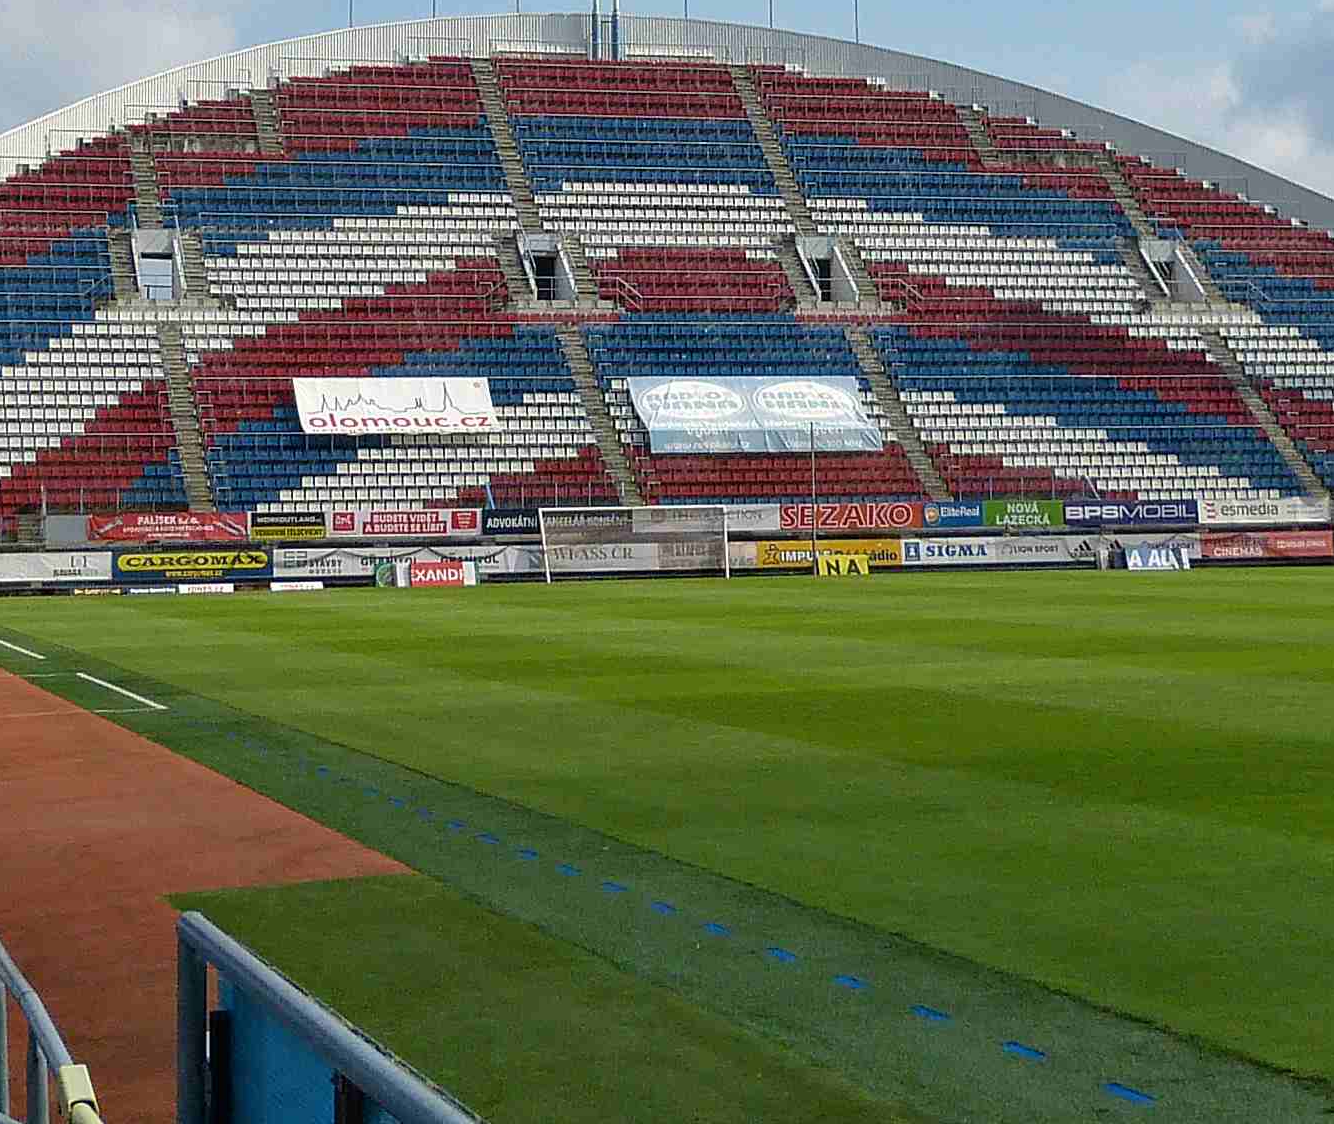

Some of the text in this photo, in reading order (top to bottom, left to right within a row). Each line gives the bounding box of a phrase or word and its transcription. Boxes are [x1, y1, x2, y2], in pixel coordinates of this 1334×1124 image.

[308, 413, 492, 428] olomouc.cz
[1006, 501, 1039, 513] NOVÁ
[1065, 505, 1196, 520] BPSMOBIL
[1220, 502, 1279, 516] esmedia
[486, 514, 539, 528] ADVOKÁTNÍ
[781, 503, 913, 529] SEZAKO
[925, 544, 988, 557] SIGMA
[126, 554, 265, 568] CARGOMAX
